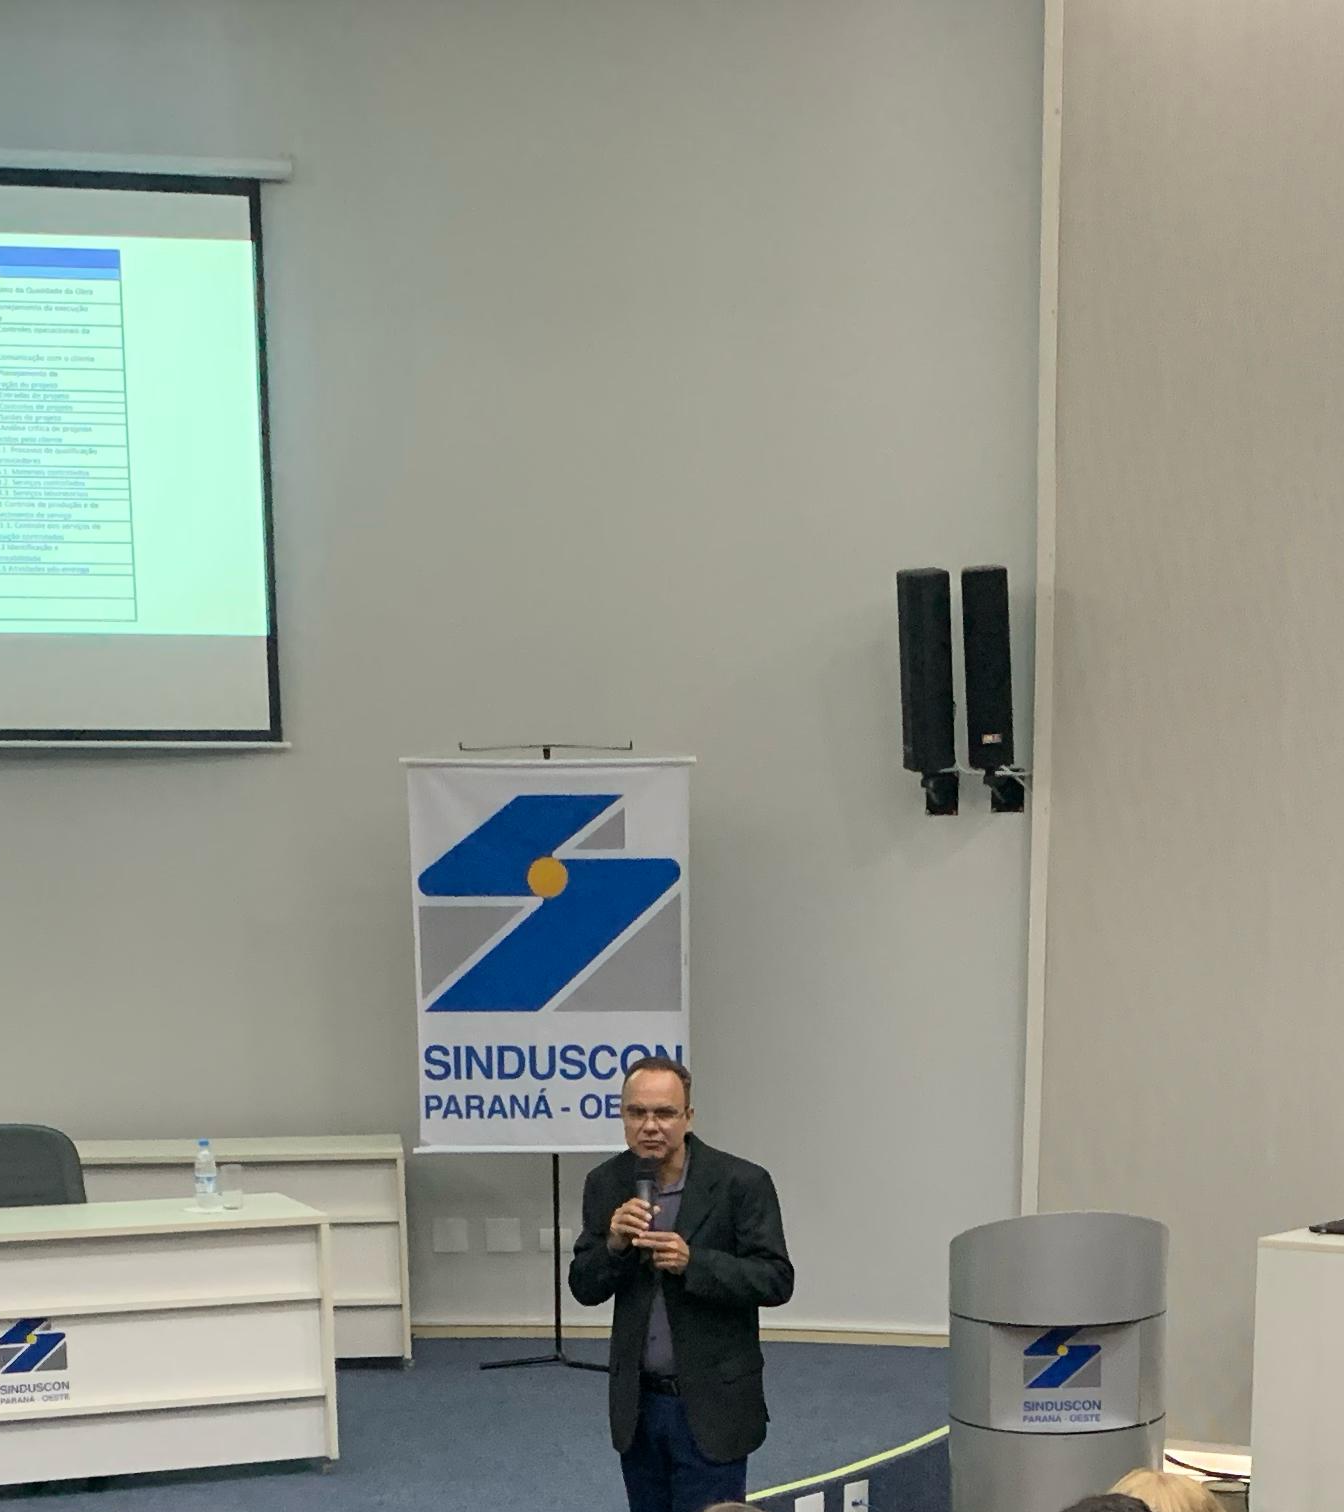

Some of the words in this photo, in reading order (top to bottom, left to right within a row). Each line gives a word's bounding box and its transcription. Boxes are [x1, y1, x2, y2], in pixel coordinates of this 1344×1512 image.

[425, 1088, 553, 1120] PARANÁ
[0, 1381, 70, 1395] SINDUSCON
[1023, 1400, 1102, 1412] SINDUSCON
